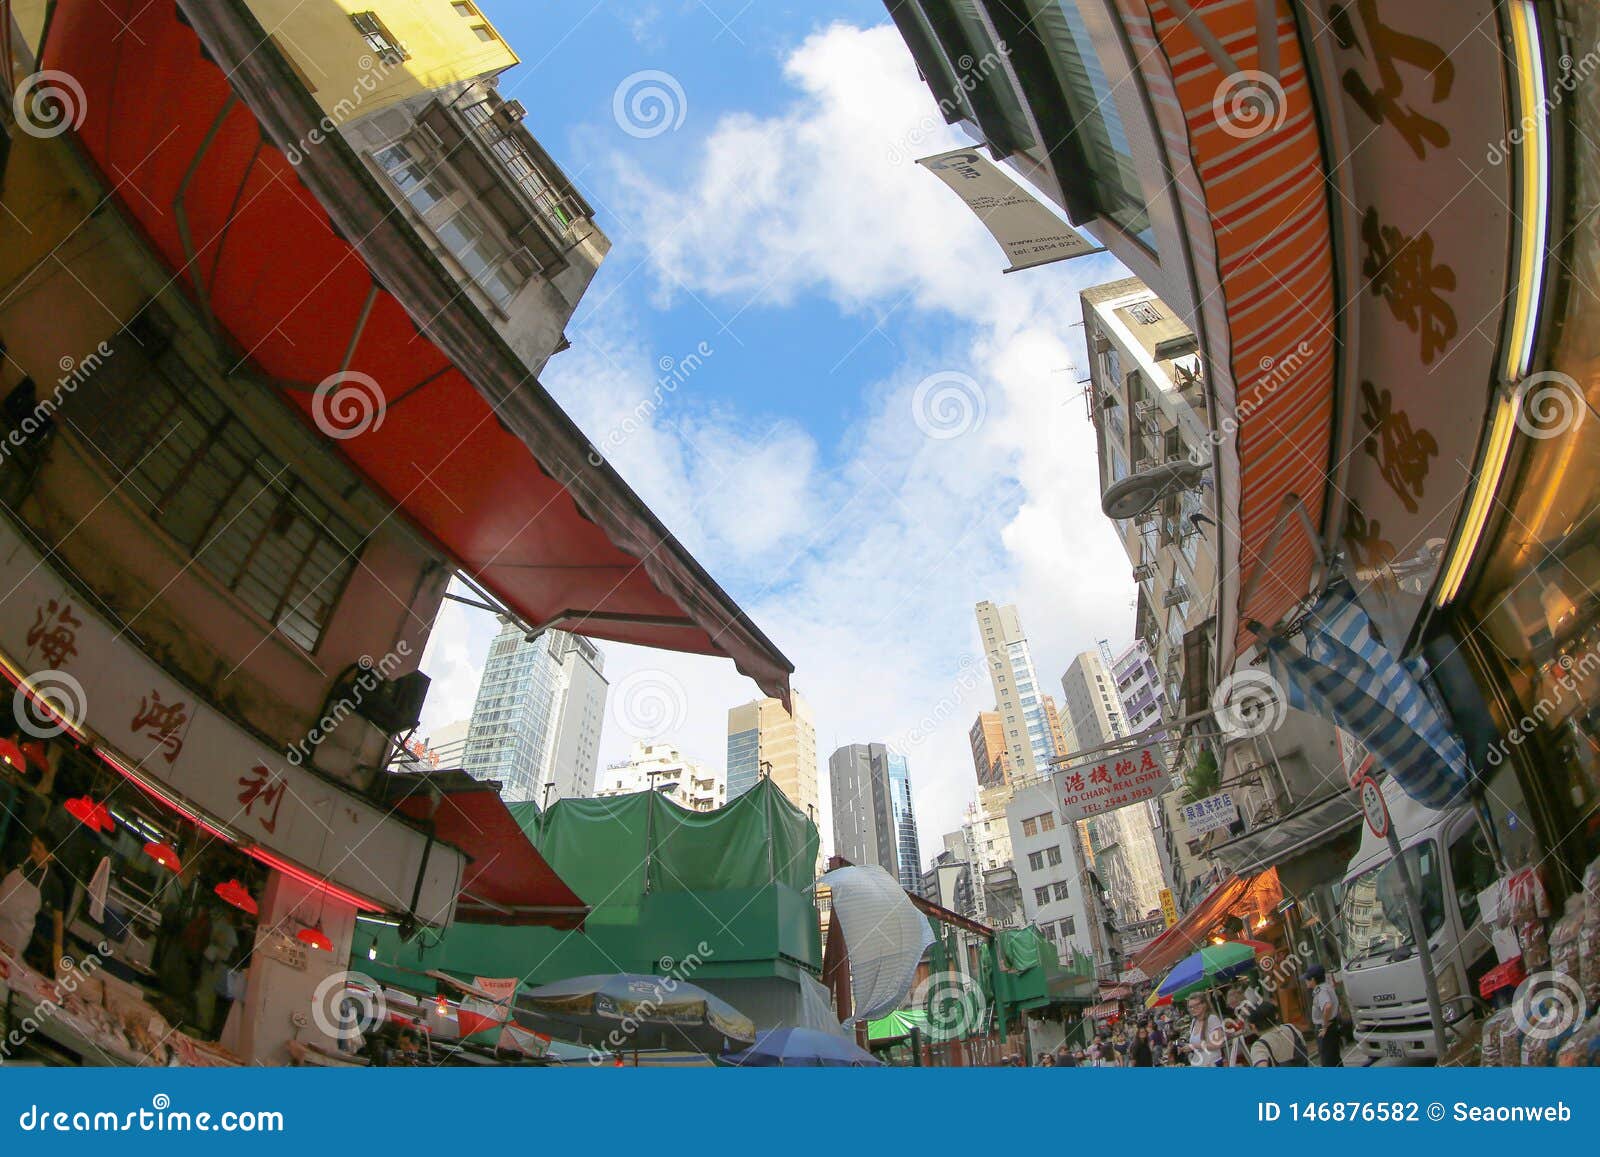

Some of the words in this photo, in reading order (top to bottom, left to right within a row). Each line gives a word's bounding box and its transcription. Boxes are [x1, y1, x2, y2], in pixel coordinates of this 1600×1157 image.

[1063, 795, 1078, 806] HO
[1080, 786, 1111, 801] CHARN
[1113, 780, 1133, 792] REAL
[1135, 769, 1163, 785] ESTATE
